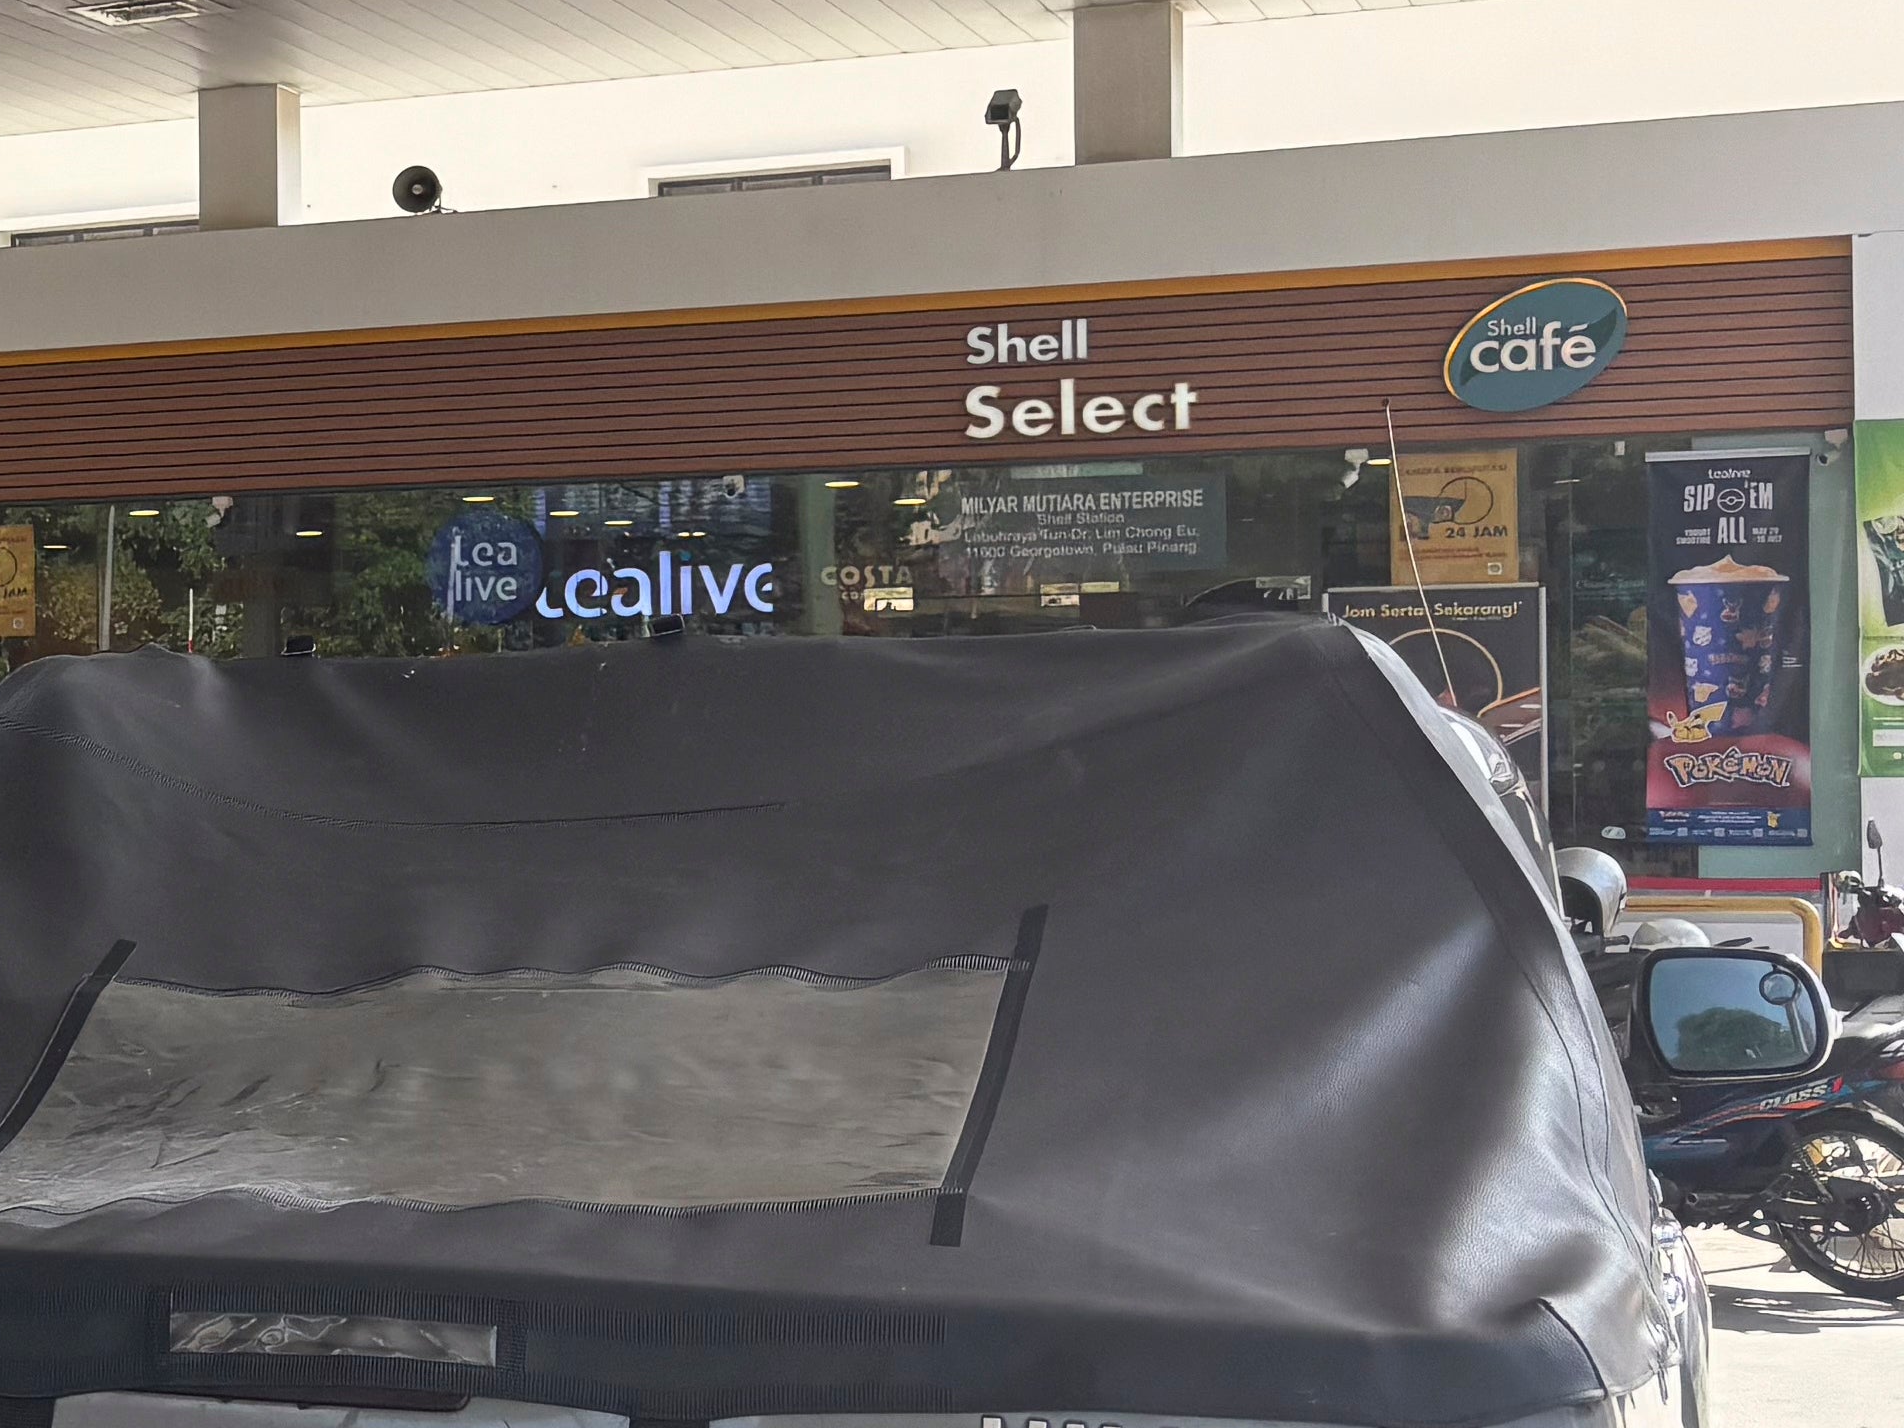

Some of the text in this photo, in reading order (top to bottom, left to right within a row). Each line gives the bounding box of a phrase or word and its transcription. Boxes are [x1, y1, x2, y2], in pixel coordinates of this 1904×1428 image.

[1486, 316, 1537, 337] Shell
[966, 318, 1088, 364] Shell
[1468, 319, 1598, 373] café
[964, 378, 1197, 439] Select
[961, 489, 1204, 514] MILYAR MUTIARA ENTERPRISE
[1684, 484, 1715, 512] SIP
[1125, 526, 1172, 539] Chong
[1445, 527, 1508, 538] 24 JAM
[1717, 516, 1747, 544] ALL
[455, 569, 518, 602] live
[821, 565, 913, 587] COSTA
[1343, 604, 1375, 618] Jom
[1758, 1083, 1828, 1110] CLASS
